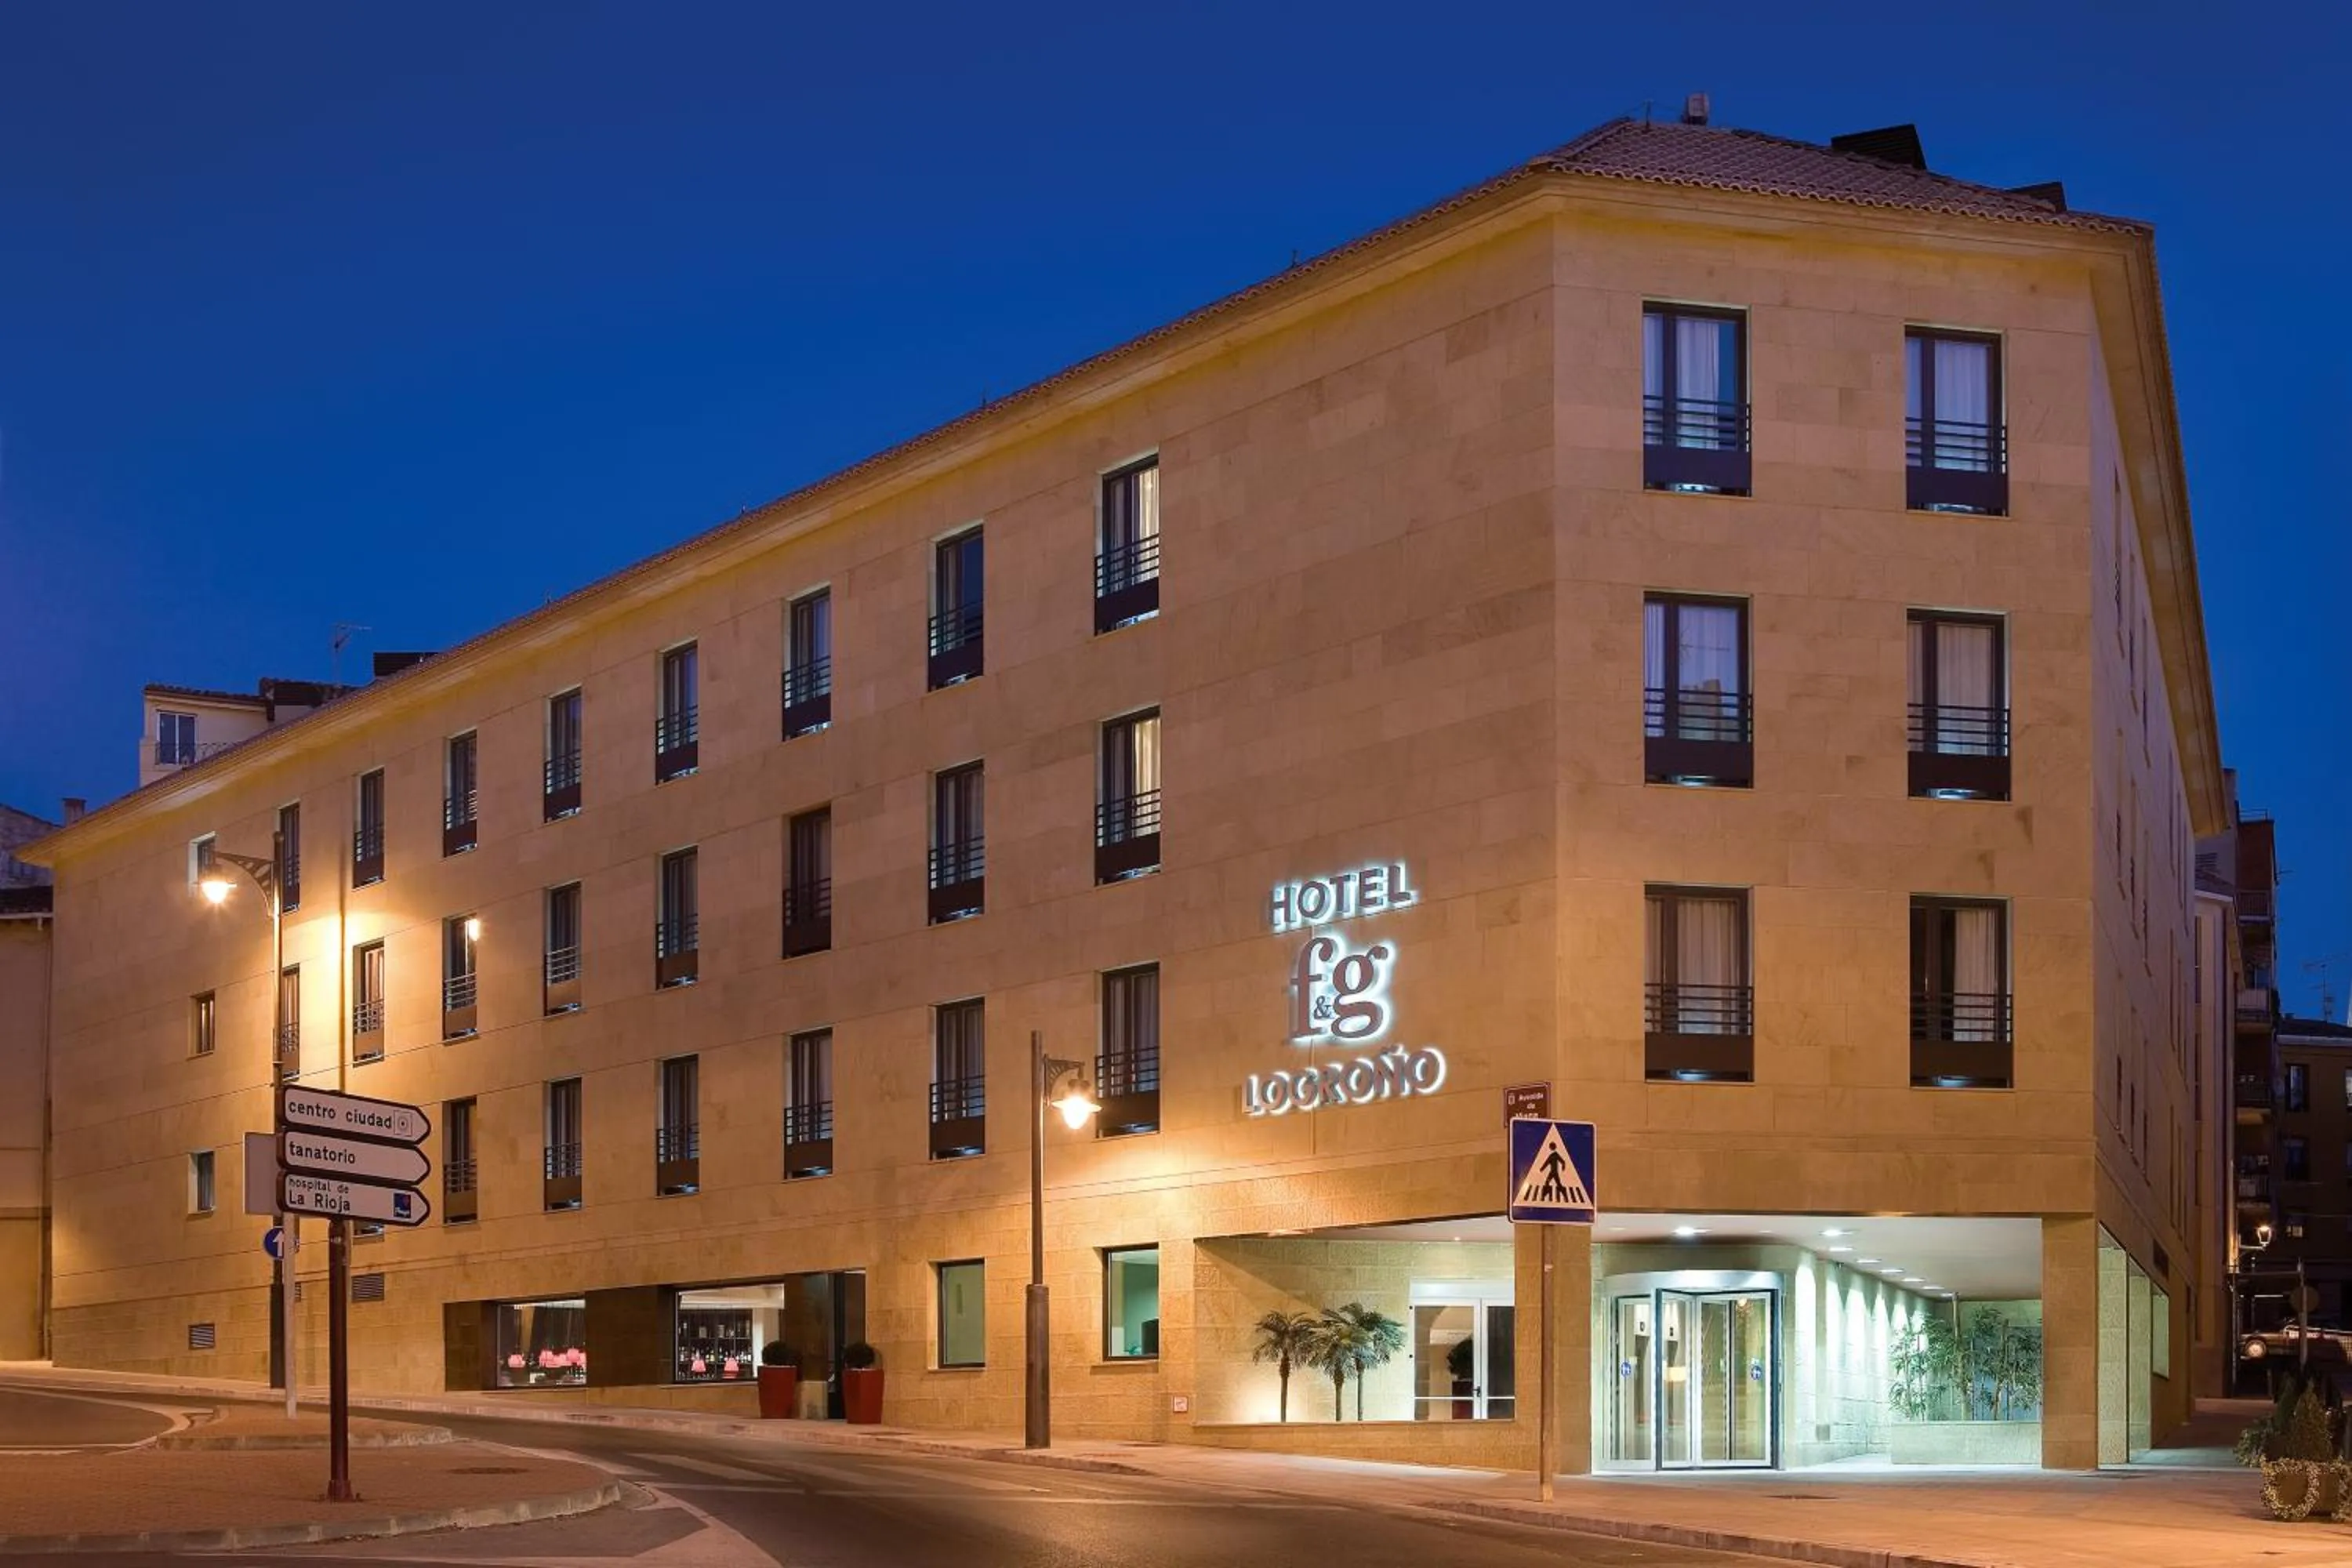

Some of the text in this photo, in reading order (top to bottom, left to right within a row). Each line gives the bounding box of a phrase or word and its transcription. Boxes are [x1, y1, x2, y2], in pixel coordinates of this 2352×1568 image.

[1269, 864, 1416, 928] HOTEL
[1242, 1046, 1446, 1116] LOGROÑO
[289, 1101, 392, 1129] centro ciudad
[289, 1141, 356, 1164] tanatorio
[289, 1178, 350, 1194] hospital de
[289, 1190, 350, 1214] La Rioja
